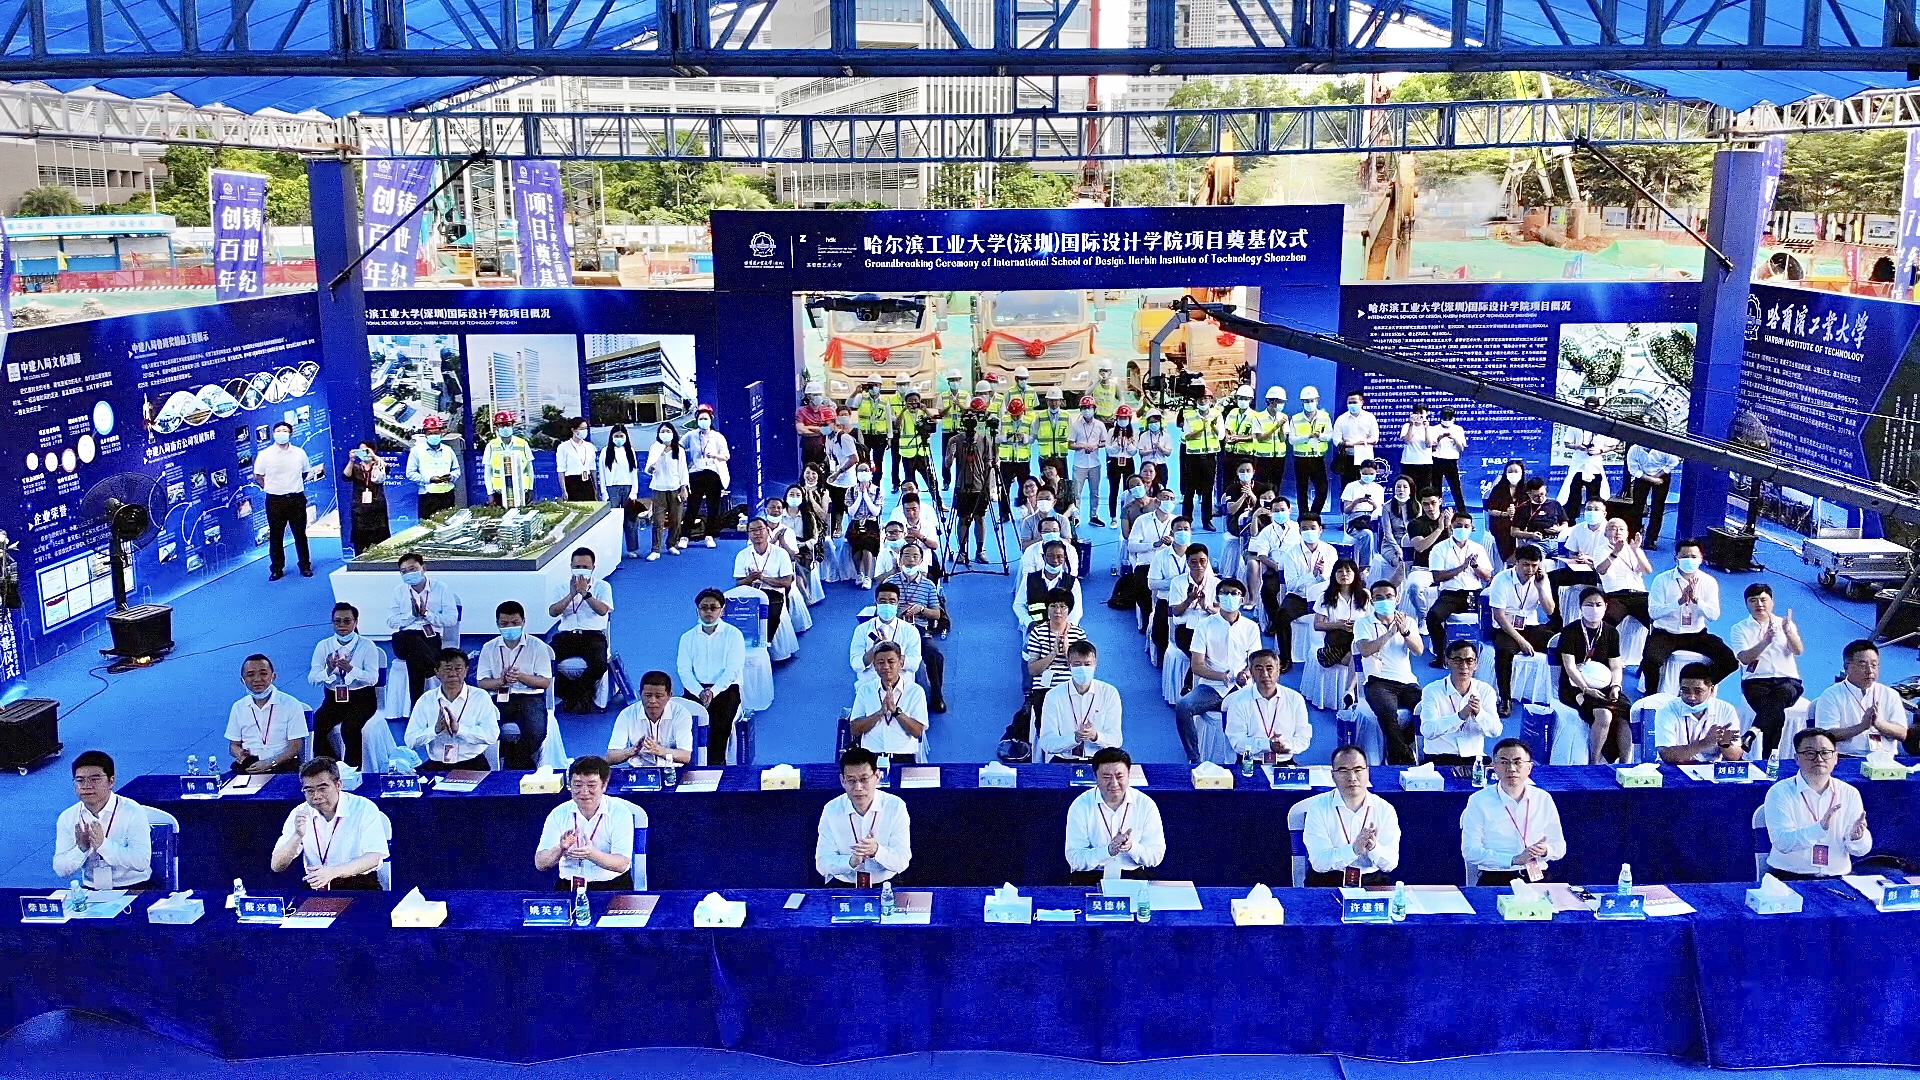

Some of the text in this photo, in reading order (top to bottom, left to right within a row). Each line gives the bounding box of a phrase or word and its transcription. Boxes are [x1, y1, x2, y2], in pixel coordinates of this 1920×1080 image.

[218, 206, 240, 293] 创百年
[238, 207, 262, 293] 铸世纪
[864, 229, 1309, 255] 哈尔滨工业大学(深圳)国际设计学院项目奠基仪式
[865, 257, 933, 270] Groundbreaking
[936, 257, 979, 270] Ceremony
[982, 257, 991, 267] of
[994, 256, 1048, 267] International
[1051, 256, 1080, 266] School
[1083, 256, 1093, 266] of
[1129, 255, 1156, 265] Harbin
[1160, 254, 1196, 264] Institute
[1199, 253, 1209, 264] of
[1211, 253, 1262, 265] Technology
[1264, 252, 1306, 263] Shenzhen
[1368, 301, 1571, 313] 哈尔滨工业大学(深圳)国际设计学院项目概况
[1764, 334, 1865, 363] HARBIN INSTITUTE OF TECHNOLOGY
[33, 503, 68, 527] 企业荣誉
[529, 905, 563, 916] 姚英学
[1092, 900, 1126, 911] 吴德林
